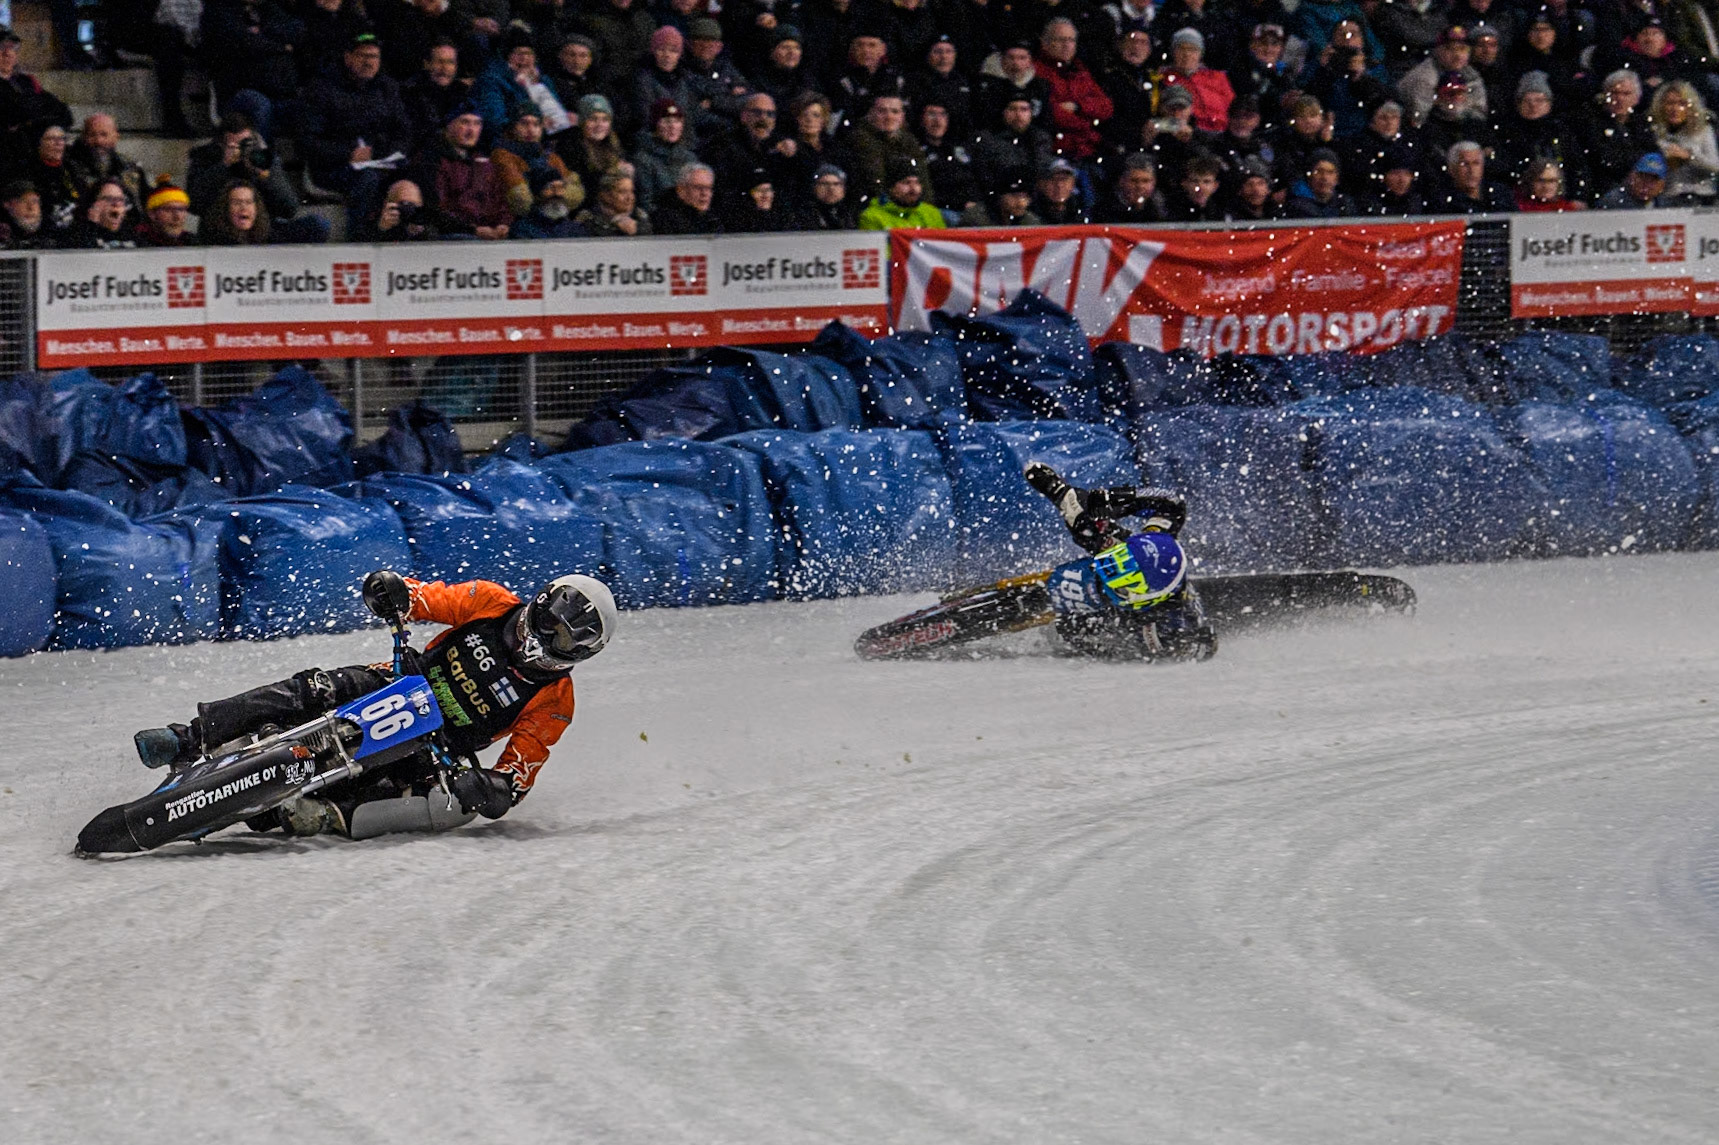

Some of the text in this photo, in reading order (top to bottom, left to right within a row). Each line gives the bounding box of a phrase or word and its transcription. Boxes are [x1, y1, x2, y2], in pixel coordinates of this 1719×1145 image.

[1520, 231, 1642, 262] Josef Fuchs
[214, 270, 329, 299] Josef Fuchs
[387, 266, 502, 296] Josef Fuchs
[551, 262, 666, 292] Josef Fuchs
[722, 256, 839, 287] Josef Fuchs
[1202, 272, 1276, 300] Jugend
[1292, 270, 1367, 291] Familie
[47, 274, 163, 305] Josef Fuchs
[1180, 304, 1450, 356] MOTORSPORT
[464, 633, 496, 672] #66
[360, 693, 415, 740] 66
[167, 772, 262, 823] AUTOTARVIKE
[262, 765, 278, 784] OY
